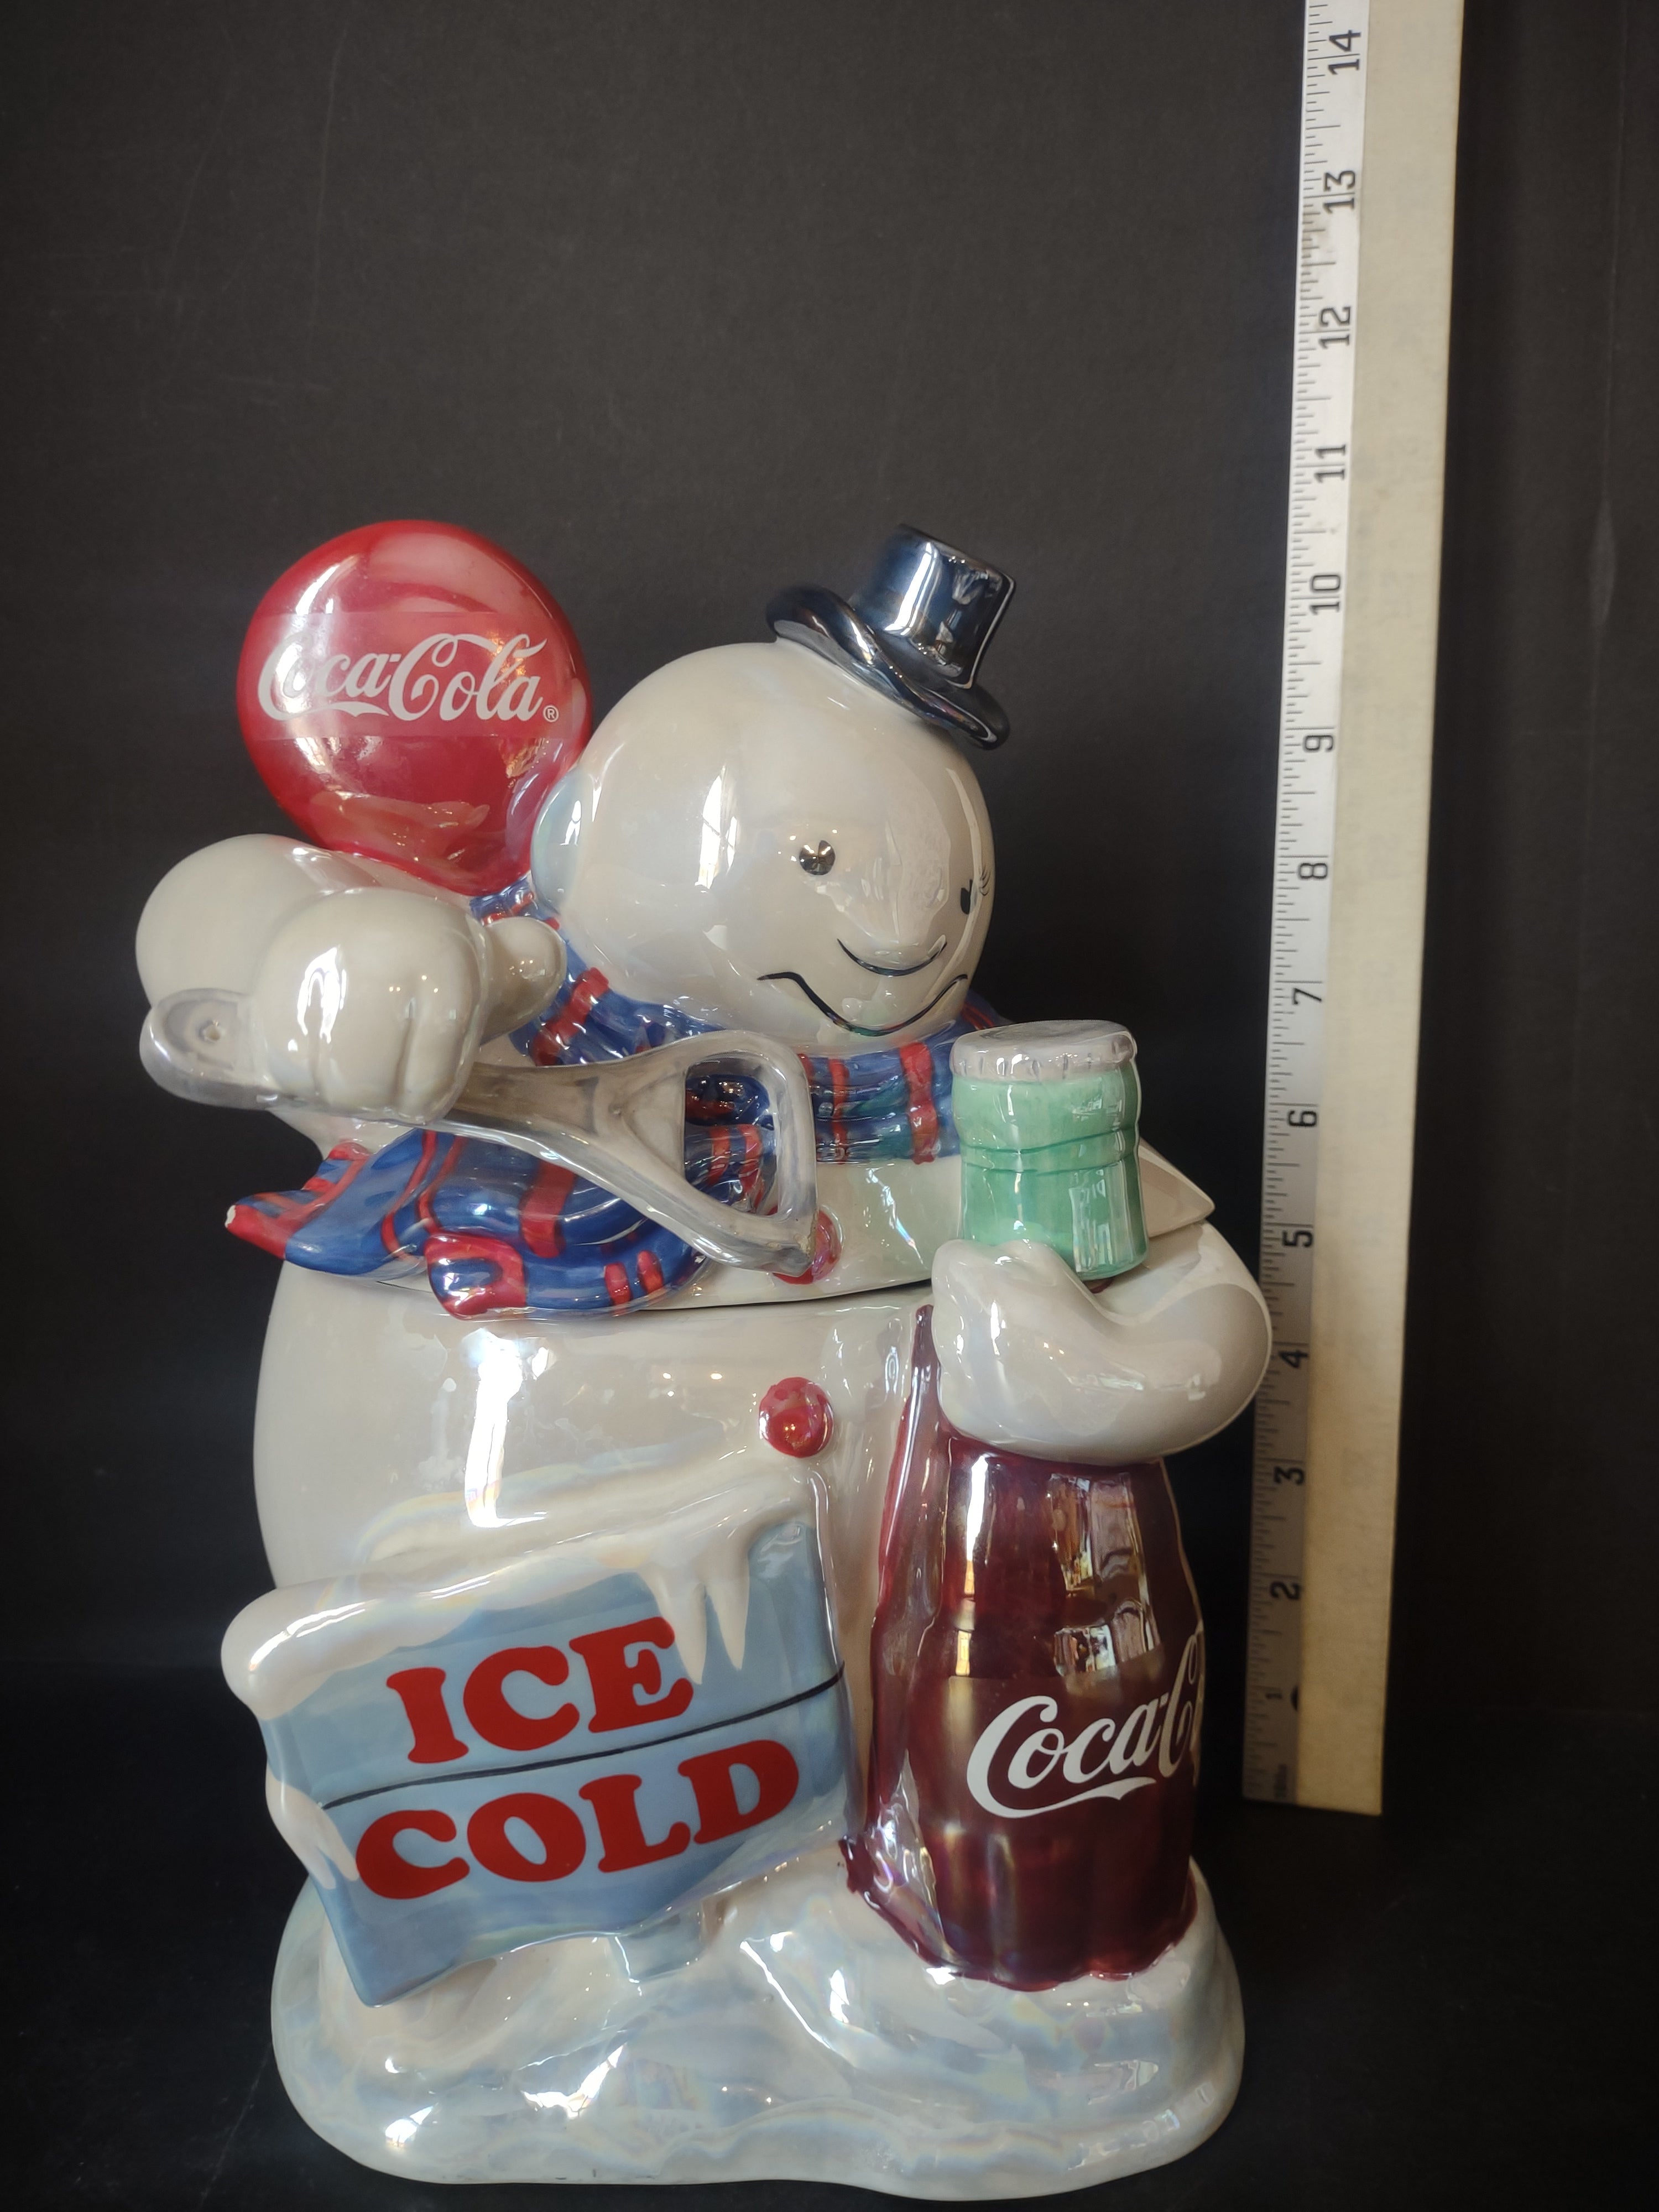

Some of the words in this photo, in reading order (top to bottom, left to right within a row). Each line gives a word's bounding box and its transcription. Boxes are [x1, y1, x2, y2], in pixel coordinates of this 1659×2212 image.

[1328, 29, 1361, 75] 14
[1323, 169, 1356, 213] 13
[1319, 306, 1350, 349] 12
[1314, 444, 1346, 483] 11
[1310, 573, 1341, 615] 10
[1303, 733, 1334, 753] 9
[1298, 862, 1328, 880] 8
[1291, 987, 1323, 1005] 7
[1287, 1109, 1317, 1128] 6
[1282, 1229, 1313, 1248] 5
[1278, 1349, 1308, 1369] 4
[1274, 1467, 1305, 1486] 3
[1270, 1581, 1301, 1601] 2
[386, 1616, 693, 1764] ICE
[356, 1739, 799, 1900] COLD
